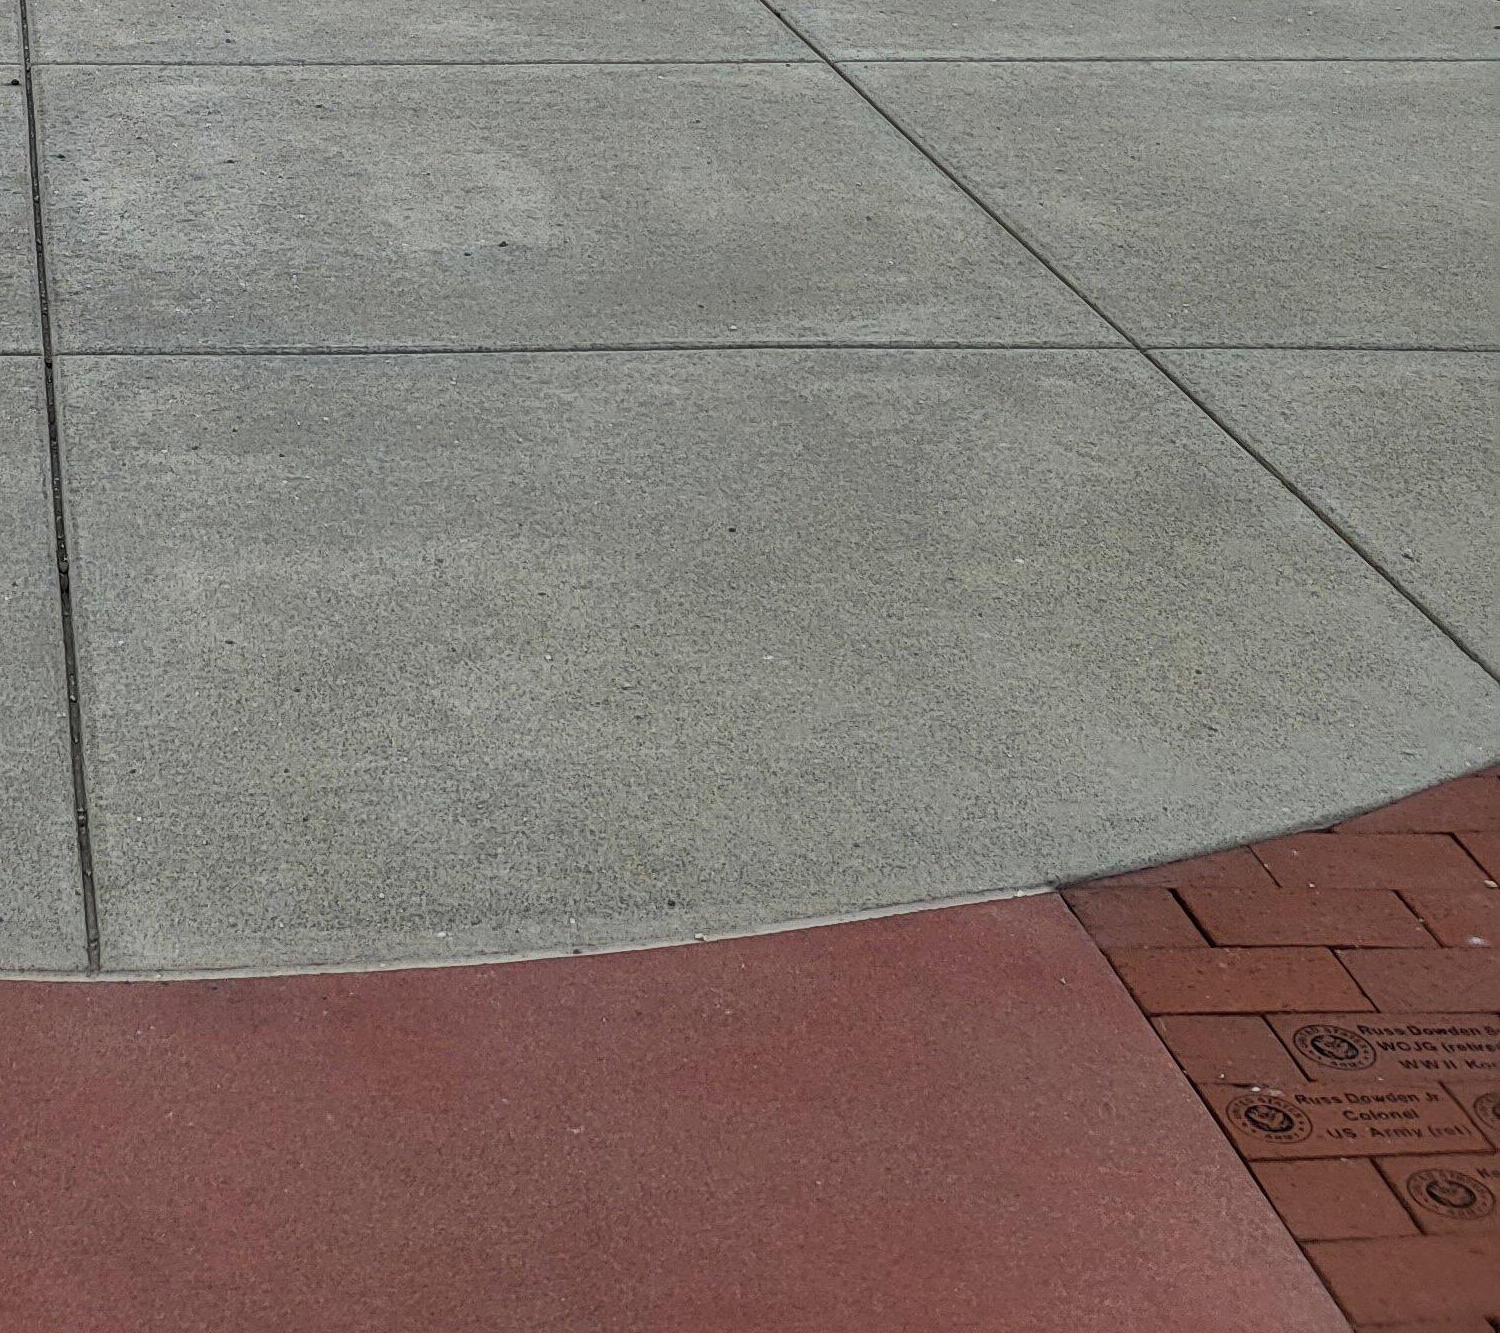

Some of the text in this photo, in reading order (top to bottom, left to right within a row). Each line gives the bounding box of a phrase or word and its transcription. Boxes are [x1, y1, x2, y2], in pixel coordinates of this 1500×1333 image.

[1294, 1093, 1343, 1105] Russ
[1344, 1092, 1420, 1105] Dowden
[1342, 1108, 1420, 1122] Colonel
[1370, 1125, 1423, 1139] Army
